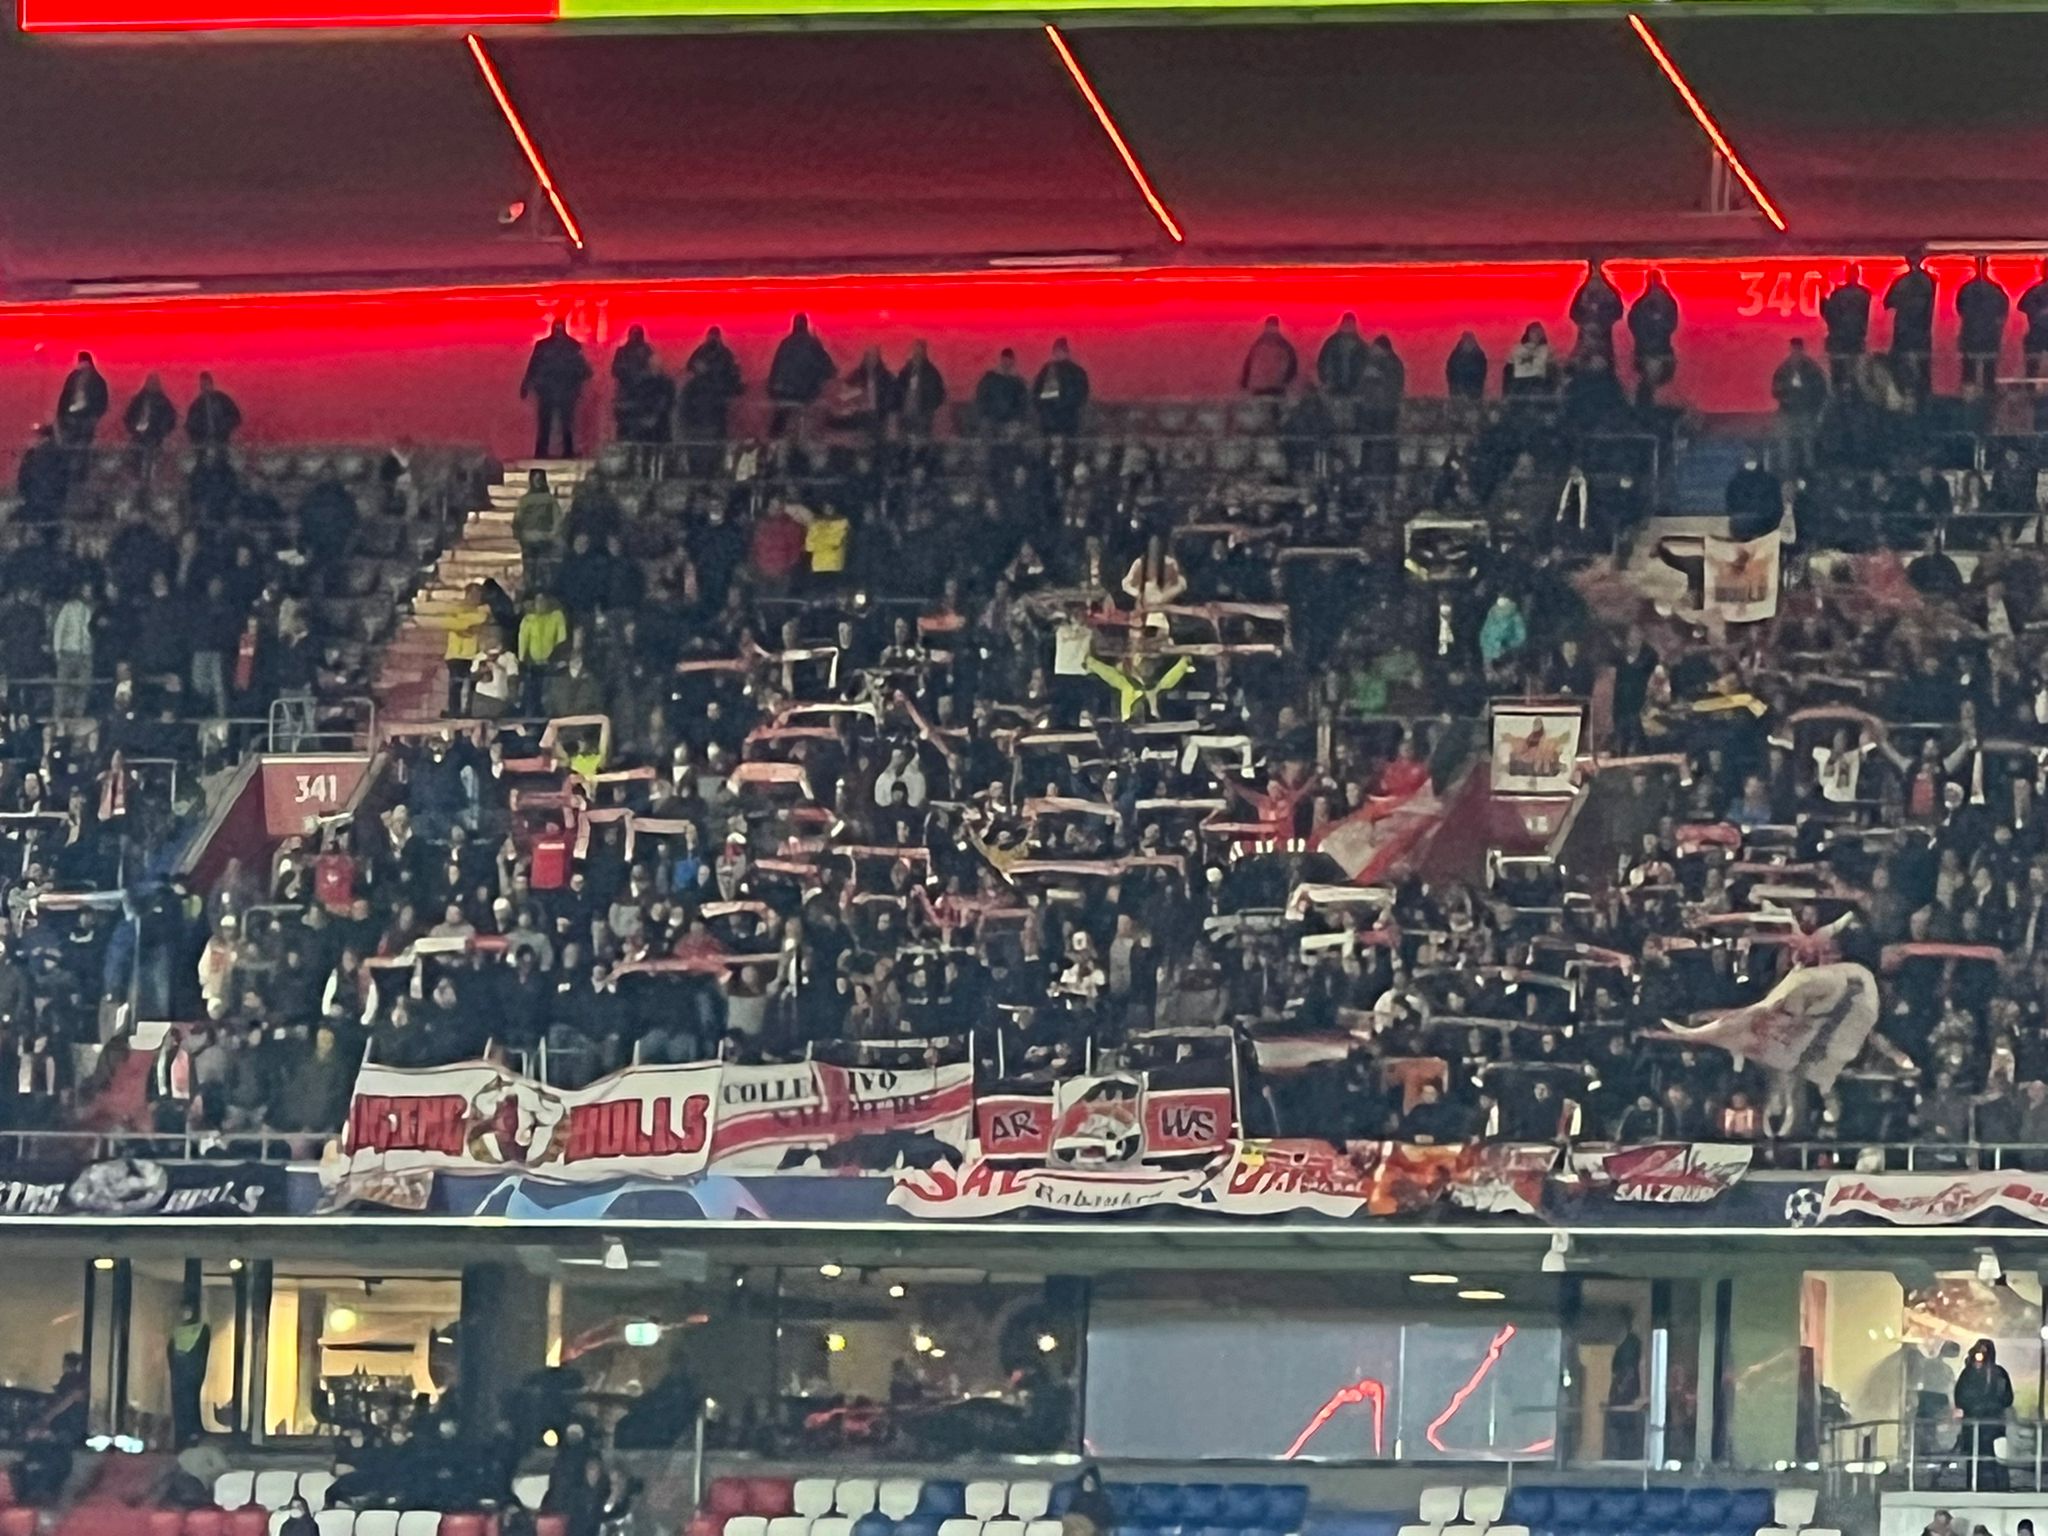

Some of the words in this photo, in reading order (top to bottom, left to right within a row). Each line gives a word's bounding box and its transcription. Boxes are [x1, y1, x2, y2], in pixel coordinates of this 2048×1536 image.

[1736, 271, 1823, 318] 340
[295, 774, 337, 803] 341
[991, 1110, 1040, 1143] AR
[1160, 1106, 1216, 1141] WS
